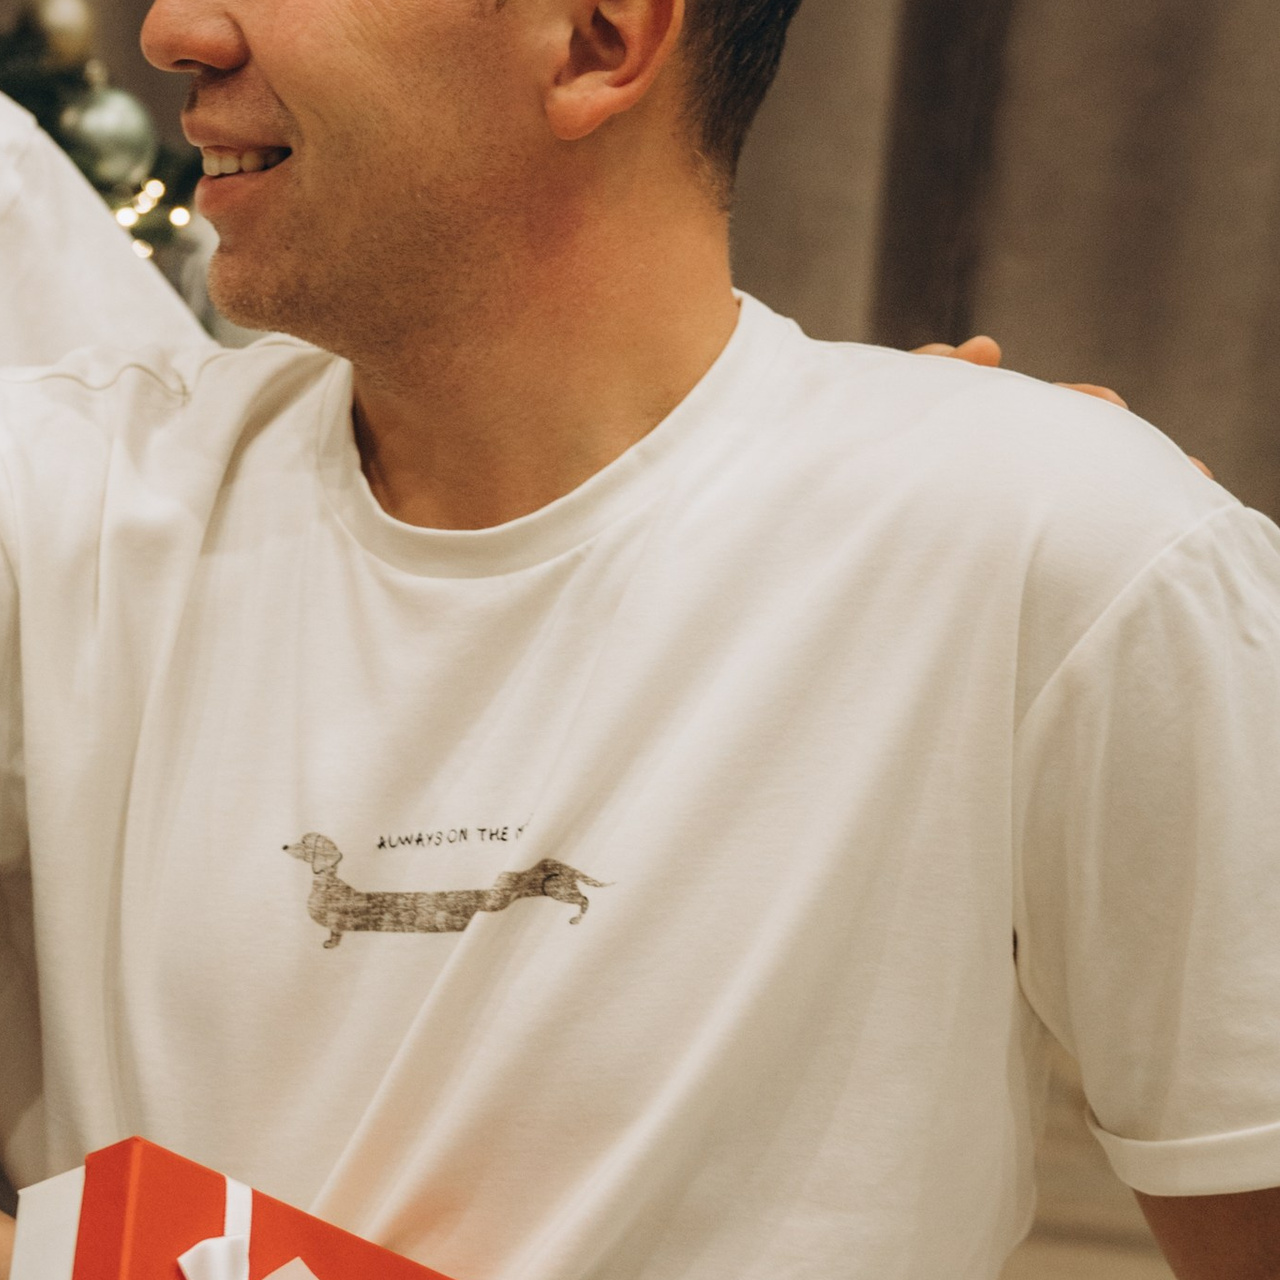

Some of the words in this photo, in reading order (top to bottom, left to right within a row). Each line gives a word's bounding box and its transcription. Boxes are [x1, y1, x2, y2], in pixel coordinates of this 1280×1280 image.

[377, 830, 443, 849] ALWAYS
[446, 828, 468, 844] ON
[477, 826, 509, 842] THE
